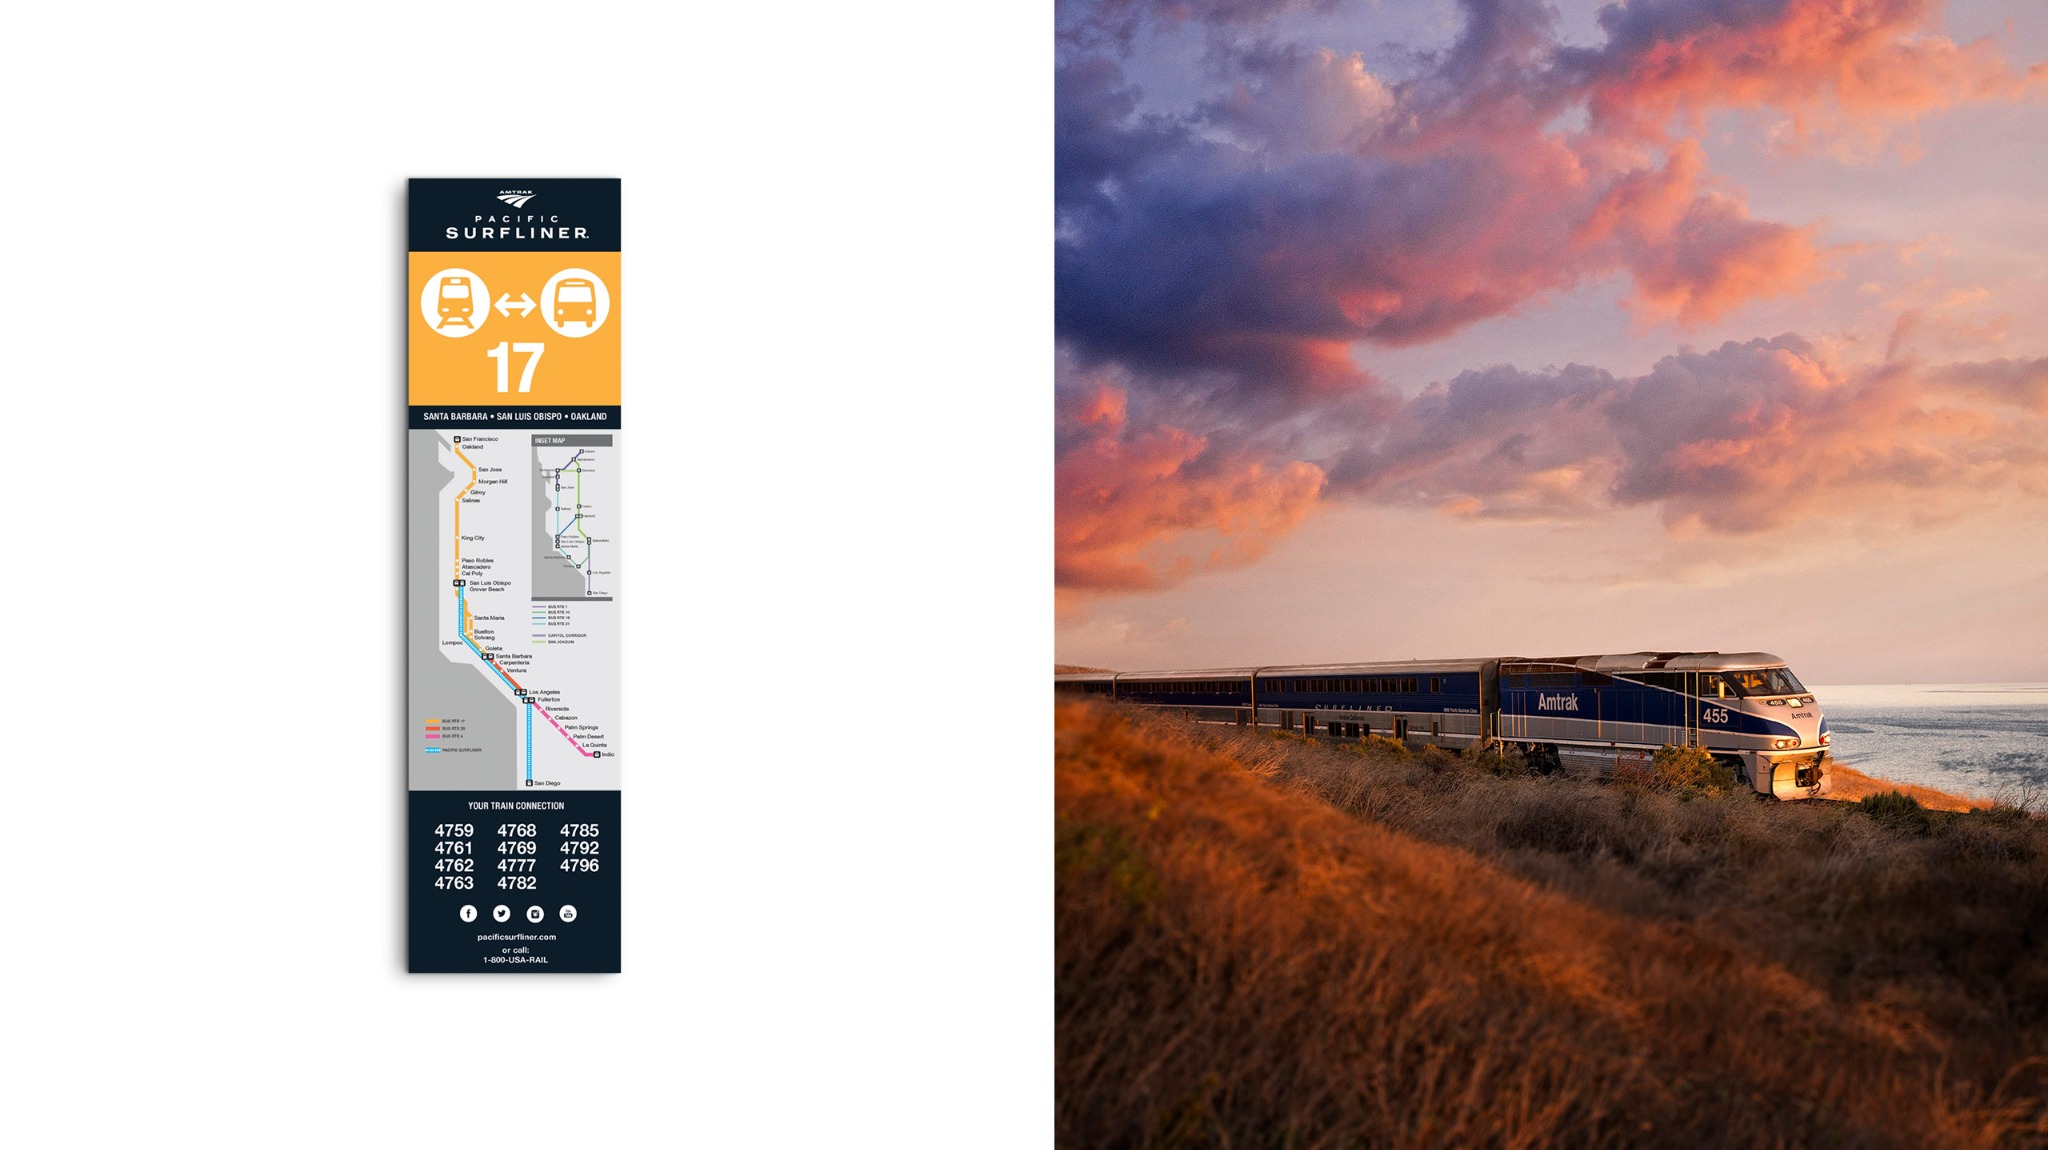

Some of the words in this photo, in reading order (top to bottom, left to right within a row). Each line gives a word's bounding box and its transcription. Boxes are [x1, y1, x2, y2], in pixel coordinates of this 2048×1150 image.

[475, 215, 559, 223] PACIFIC
[487, 342, 544, 393] 17
[423, 412, 449, 420] SANTA
[451, 412, 488, 420] BARBARA
[497, 412, 513, 420] SAN
[515, 412, 532, 420] LUIS
[534, 412, 562, 420] OBISPO
[571, 412, 607, 420] OAKLAND
[1538, 692, 1579, 711] Amtrak
[1703, 708, 1729, 724] 455
[468, 802, 489, 810] YOUR
[491, 802, 514, 810] TRAIN
[516, 802, 565, 810] CONNECTION
[435, 824, 474, 837] 4759
[497, 824, 537, 837] 4768
[560, 824, 599, 837] 4785
[435, 841, 472, 854] 4761
[497, 841, 537, 854] 4769
[560, 841, 599, 854] 4792
[435, 859, 474, 872] 4762
[497, 859, 537, 872] 4777
[560, 859, 599, 872] 4796
[435, 876, 474, 889] 4763
[497, 876, 537, 889] 4782
[477, 933, 556, 941] pacificsurfliner.com
[483, 956, 548, 964] 1-800-USA-RAIL
